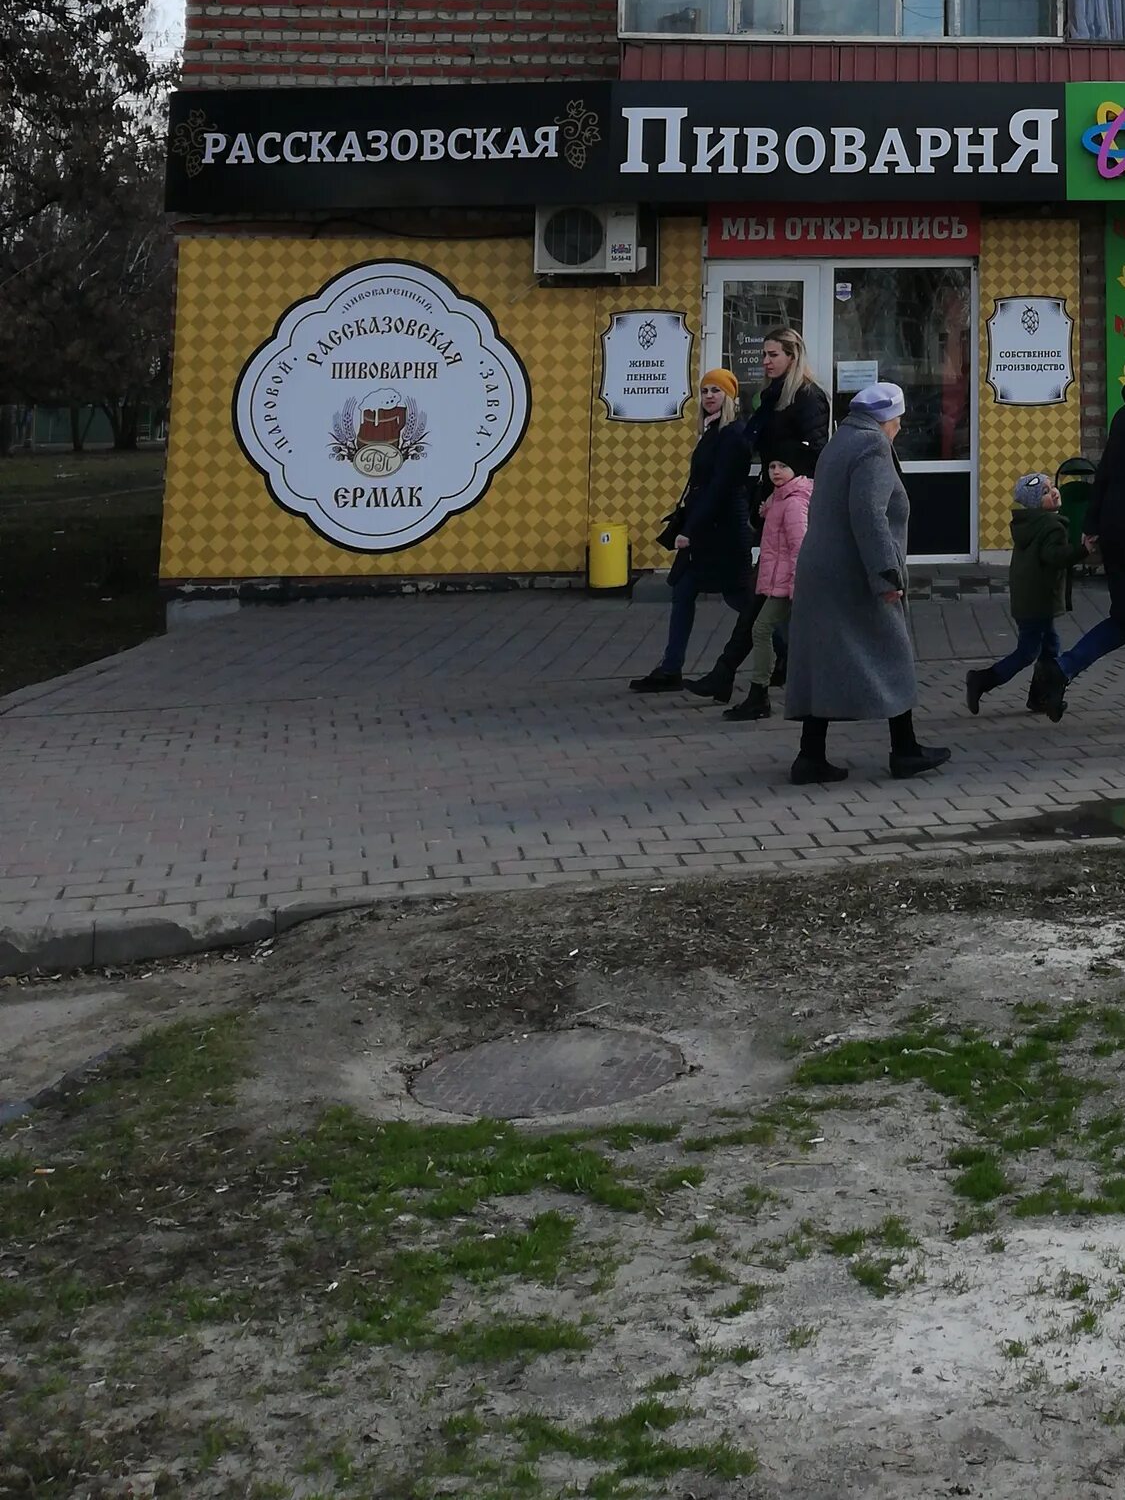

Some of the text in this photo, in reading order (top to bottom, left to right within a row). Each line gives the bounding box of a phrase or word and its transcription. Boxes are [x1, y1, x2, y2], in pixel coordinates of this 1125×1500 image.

[201, 124, 560, 165] РАССКАЗОВСКАЯ
[619, 106, 1059, 174] ПИВОВАРНЯ
[720, 215, 969, 242] МЫ ОТКРЫЛИСЬ
[343, 287, 432, 312] ПИВОВАРЕННЫЙ
[306, 315, 463, 367] РАССКАЗОВСКАЯ
[628, 360, 665, 368] ЖИВЫЕ
[999, 350, 1062, 359] СОБСТВЕННОЕ
[330, 361, 439, 380] ПИВОВАРНЯ
[626, 373, 667, 381] ПЕННЫЕ
[996, 363, 1065, 372] ПРОИЗВОДСТВО
[623, 386, 669, 395] НАПИТКИ
[263, 358, 293, 451] ПАРОВОЙ
[475, 368, 500, 440] ЗАВОД
[333, 486, 424, 509] ЕРМАК
